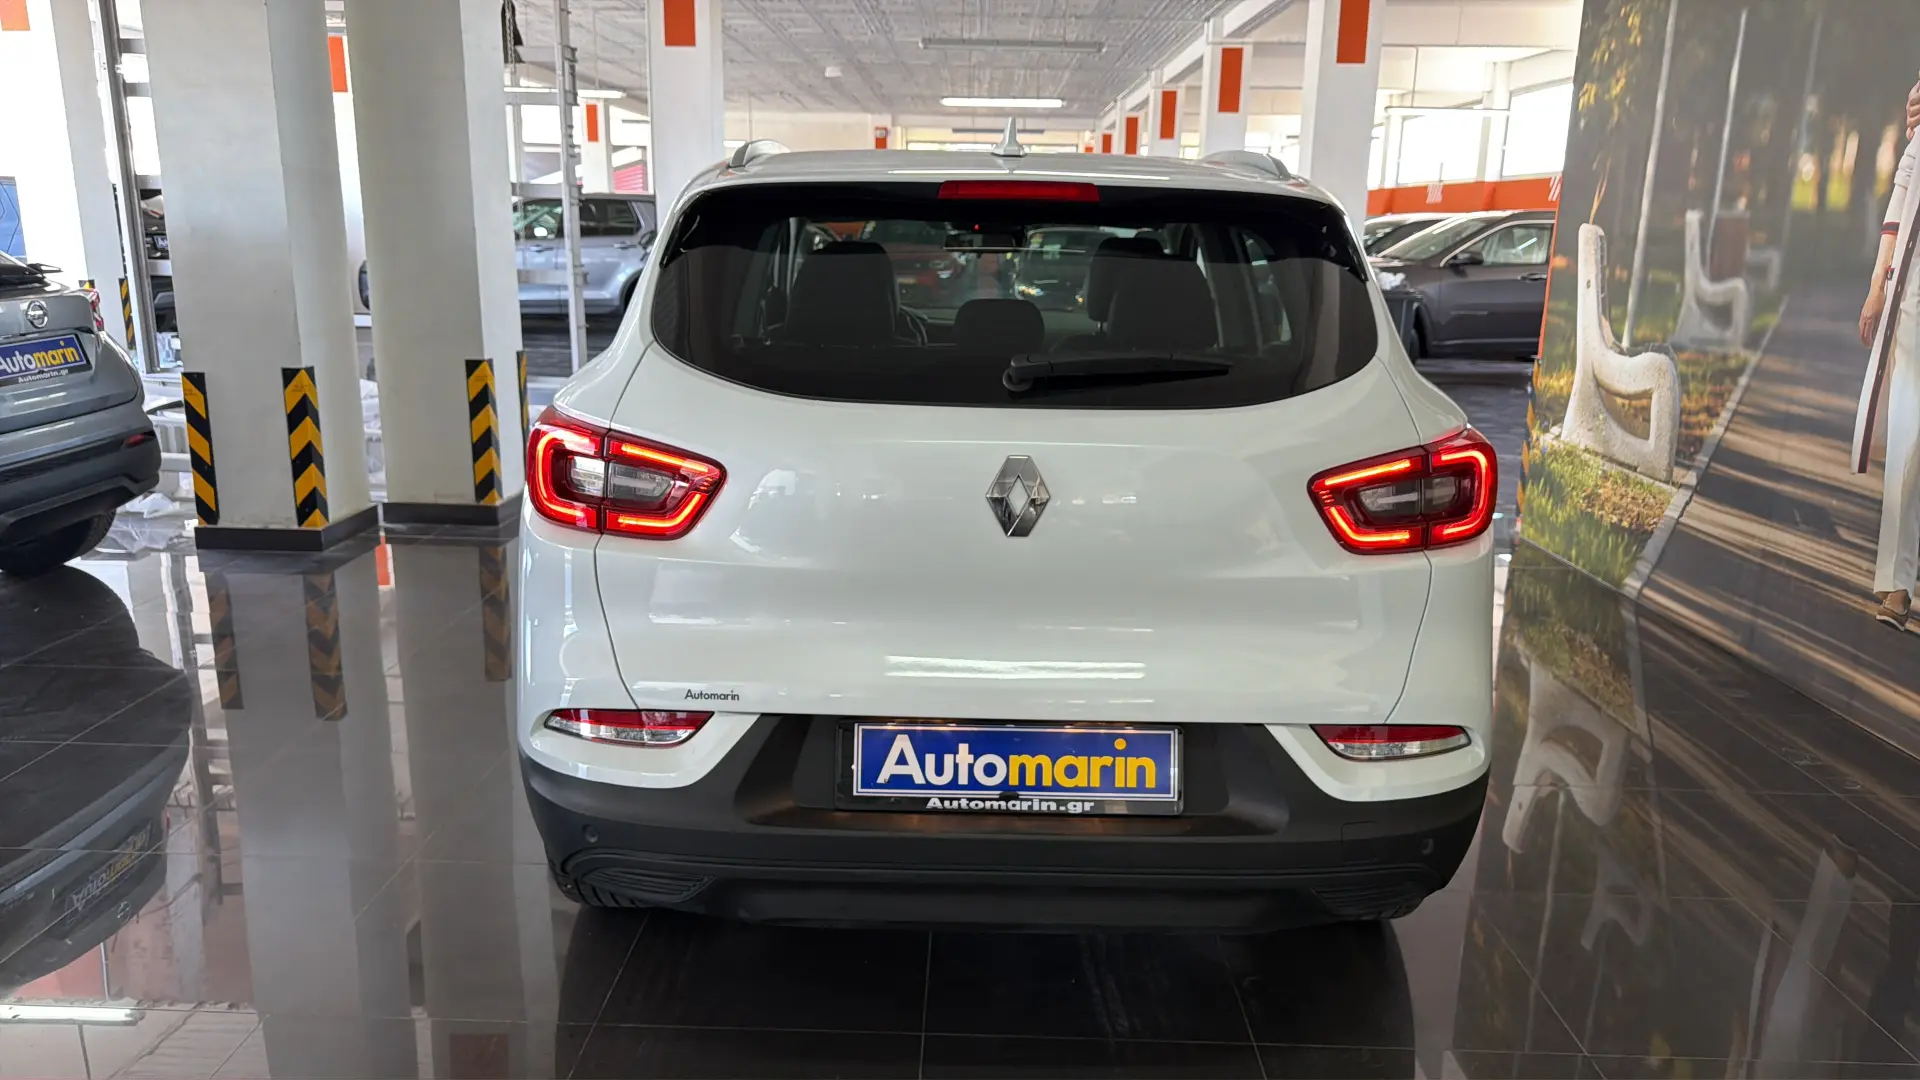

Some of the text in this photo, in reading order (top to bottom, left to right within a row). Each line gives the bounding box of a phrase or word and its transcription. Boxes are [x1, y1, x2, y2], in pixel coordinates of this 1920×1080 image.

[0, 340, 79, 374] Automarin
[684, 688, 740, 701] Automarin
[876, 734, 1156, 789] Automarin
[926, 797, 1095, 814] Automarin.gr
